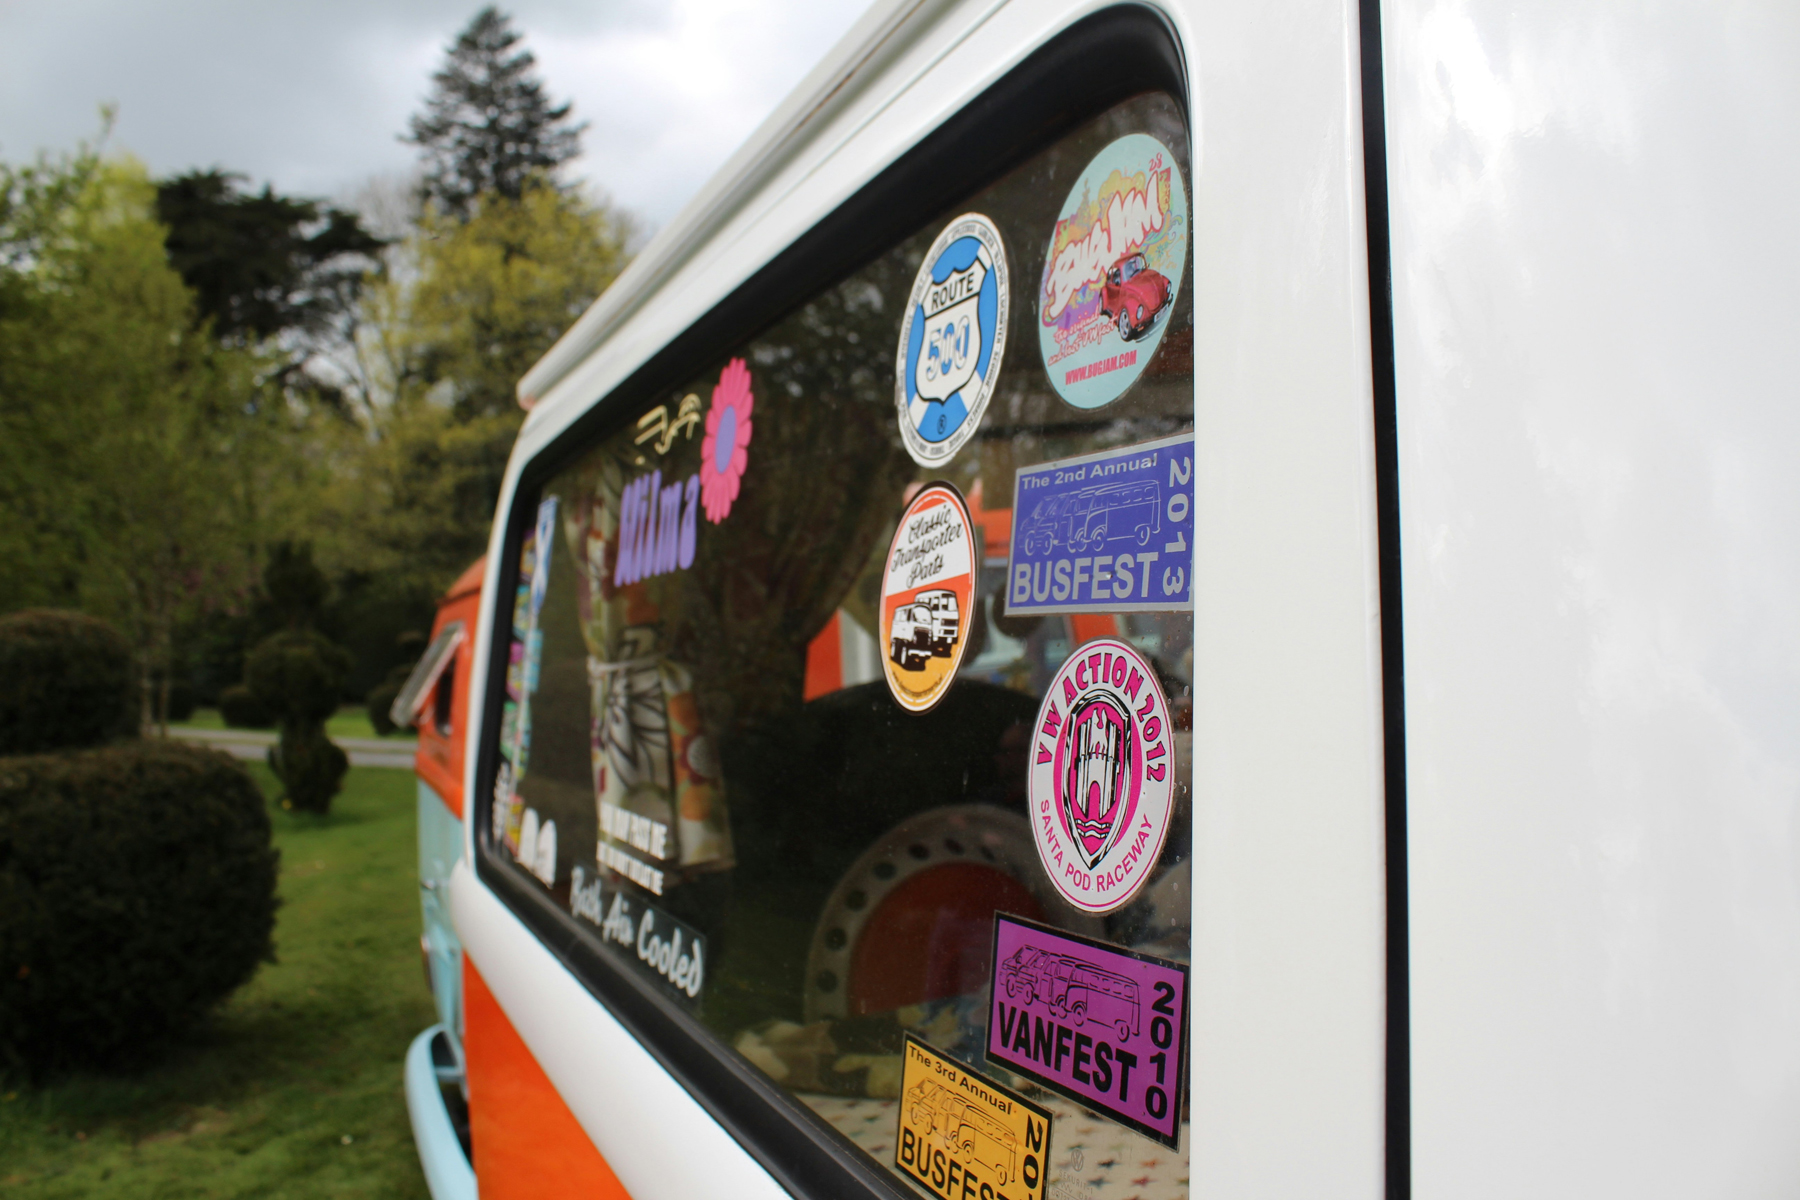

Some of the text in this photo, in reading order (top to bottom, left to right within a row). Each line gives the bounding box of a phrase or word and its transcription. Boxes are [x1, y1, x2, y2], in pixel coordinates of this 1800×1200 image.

[930, 271, 974, 311] ROUTE
[926, 314, 970, 382] 500
[1065, 349, 1137, 385] WWW.BUGJAM.COM
[1021, 452, 1158, 490] The 2nd Annual
[890, 522, 964, 573] Transporter
[908, 504, 952, 544] Classic
[1162, 456, 1191, 597] 2013
[906, 553, 945, 589] Parts
[1012, 552, 1159, 604] BUSFEST
[1062, 652, 1144, 708] ACTION
[1137, 693, 1167, 783] 2012
[1041, 799, 1153, 892] SANTA POD RACEWAY
[637, 908, 703, 998] Cooled
[909, 1045, 1013, 1115] The 3rd Annual
[998, 1001, 1138, 1103] VANFEST
[1145, 981, 1176, 1120] 2010
[901, 1126, 1010, 1200] BUSFE
